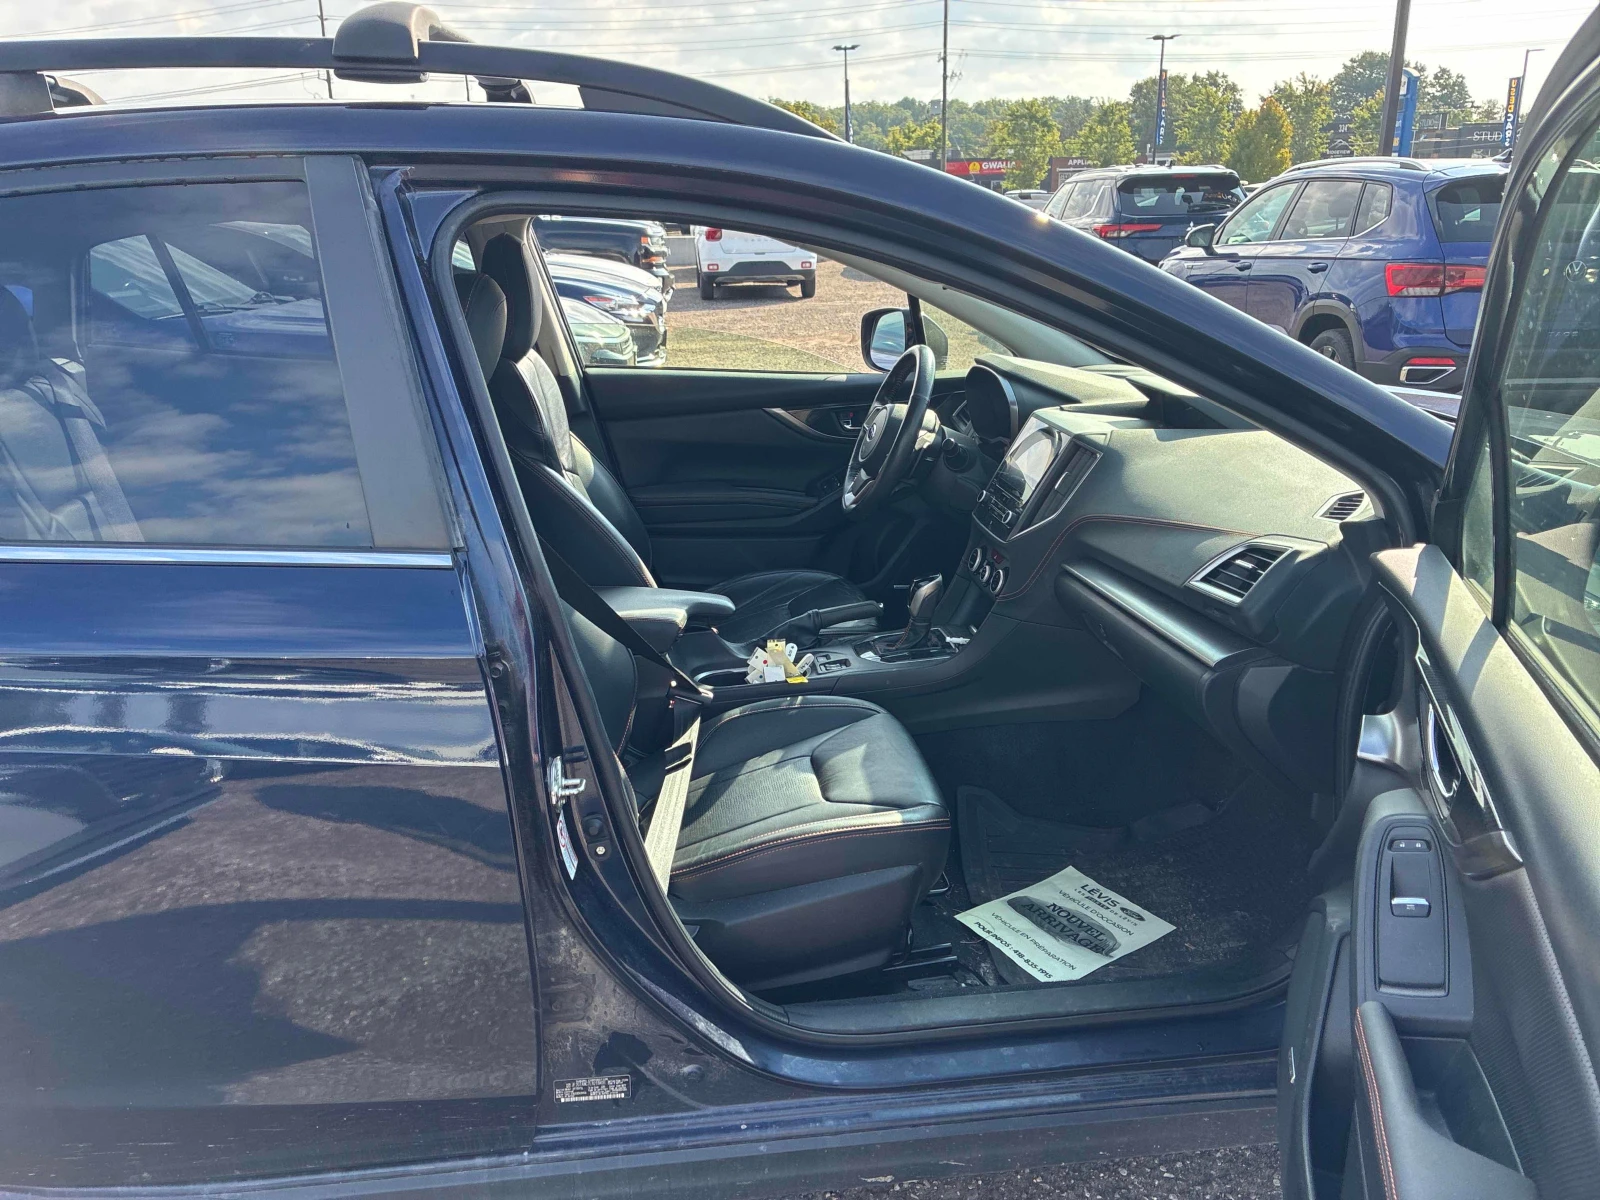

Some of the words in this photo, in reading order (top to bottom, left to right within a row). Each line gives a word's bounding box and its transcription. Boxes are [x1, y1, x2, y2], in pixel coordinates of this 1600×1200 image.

[1057, 889, 1091, 912] VÉHICULE
[1089, 908, 1135, 936] D'OCCASION
[1080, 883, 1120, 907] LÉVIS
[974, 921, 993, 935] POUR
[991, 912, 1022, 934] VÉHICULE
[1019, 931, 1032, 940] EN
[1029, 938, 1077, 971] PRÉPARATION
[1020, 903, 1108, 954] ARRIVAGE
[1046, 902, 1106, 942] NOUVEL
